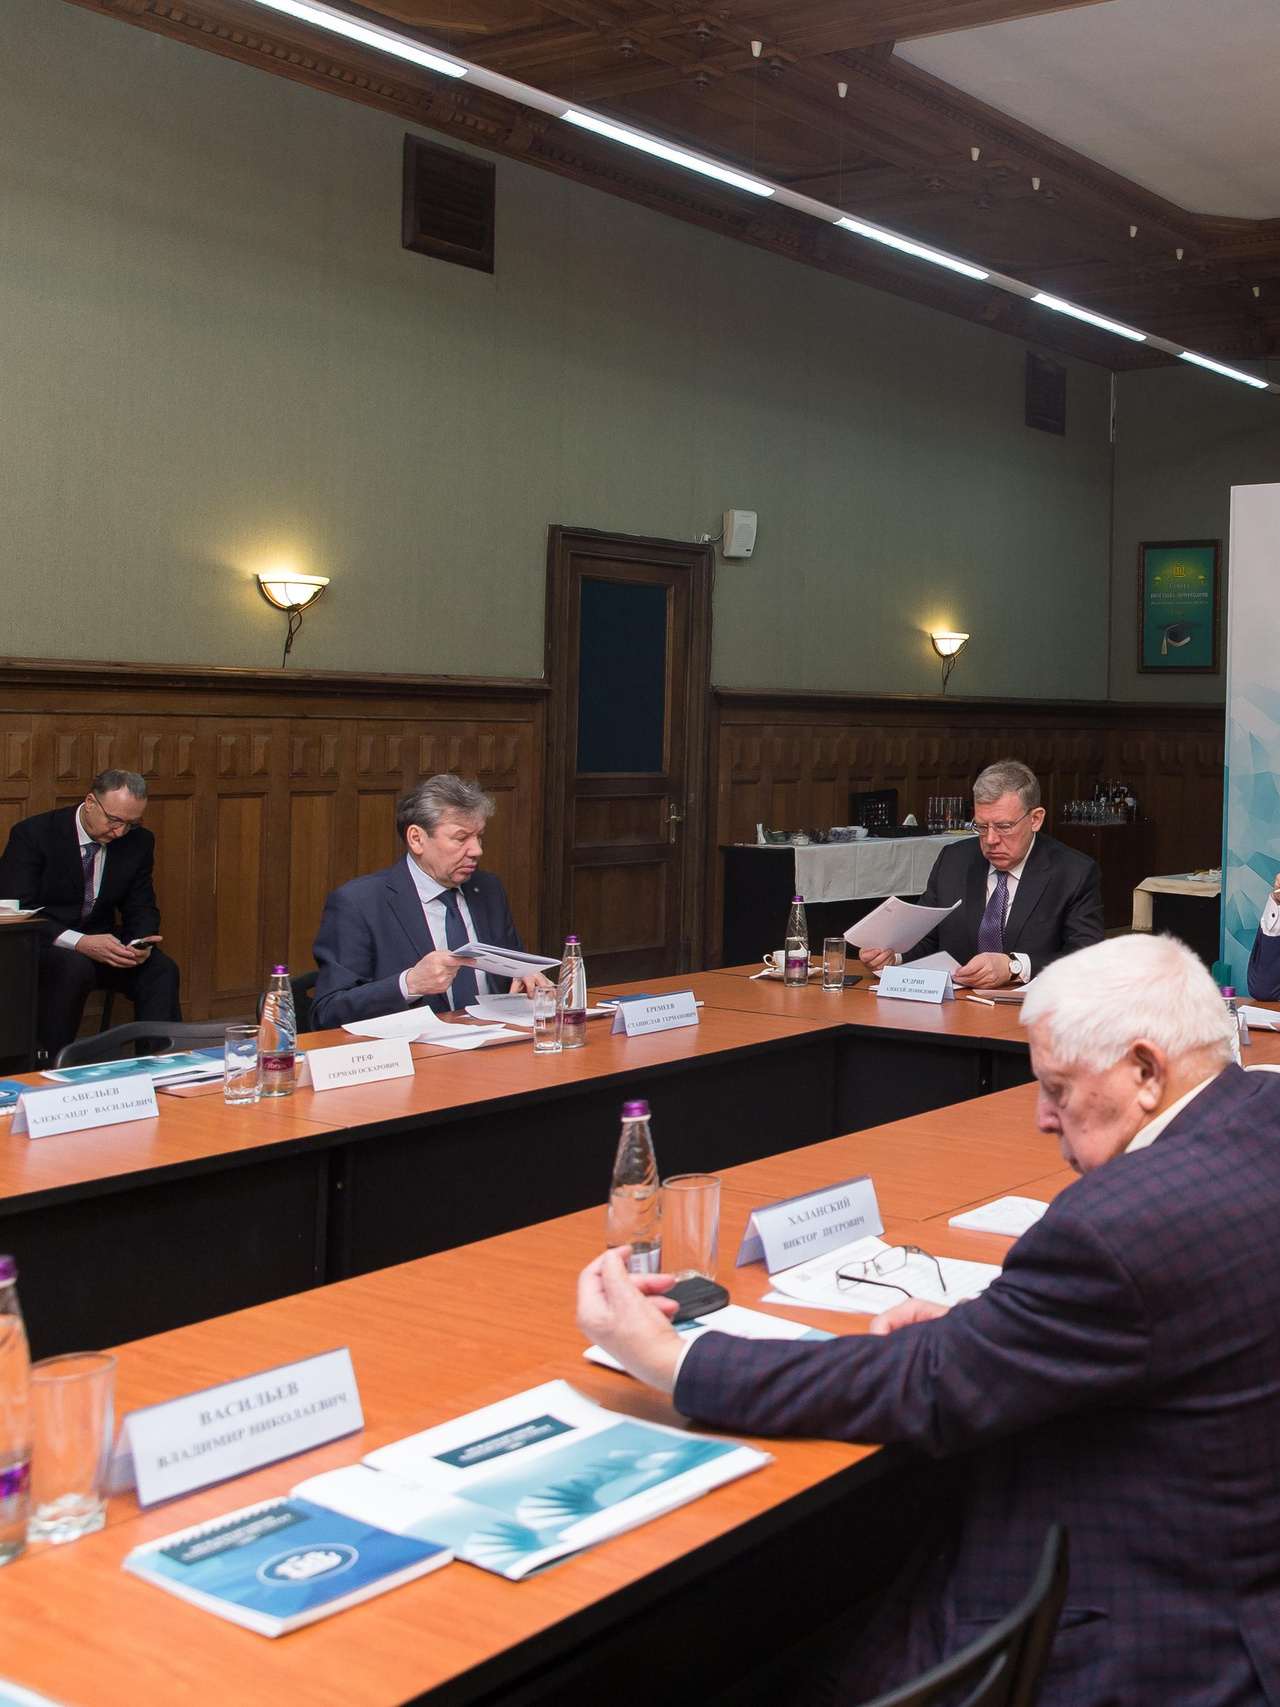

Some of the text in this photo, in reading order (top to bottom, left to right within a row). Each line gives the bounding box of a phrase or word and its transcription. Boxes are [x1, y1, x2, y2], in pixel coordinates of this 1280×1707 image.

[646, 1002, 675, 1013] ЕРЕМЕЕВ
[328, 1061, 399, 1079] ГЕРМАН ОСКАРОВИЧ
[351, 1053, 374, 1063] ГРЕФ
[62, 1087, 120, 1104] САВЕЛЬЕВ
[31, 1097, 153, 1125] АЛЕКСАНДР ВАСИЛЬЕВИЧ
[788, 1196, 851, 1225] ХАЛАНСКИЙ
[782, 1215, 865, 1250] ВИКТОР ПЕТРОВИЧ
[199, 1381, 299, 1427] ВАСИЛЬЕВ
[156, 1392, 348, 1468] ВЛАДИМИР НИКОЛАЕВИЧ
